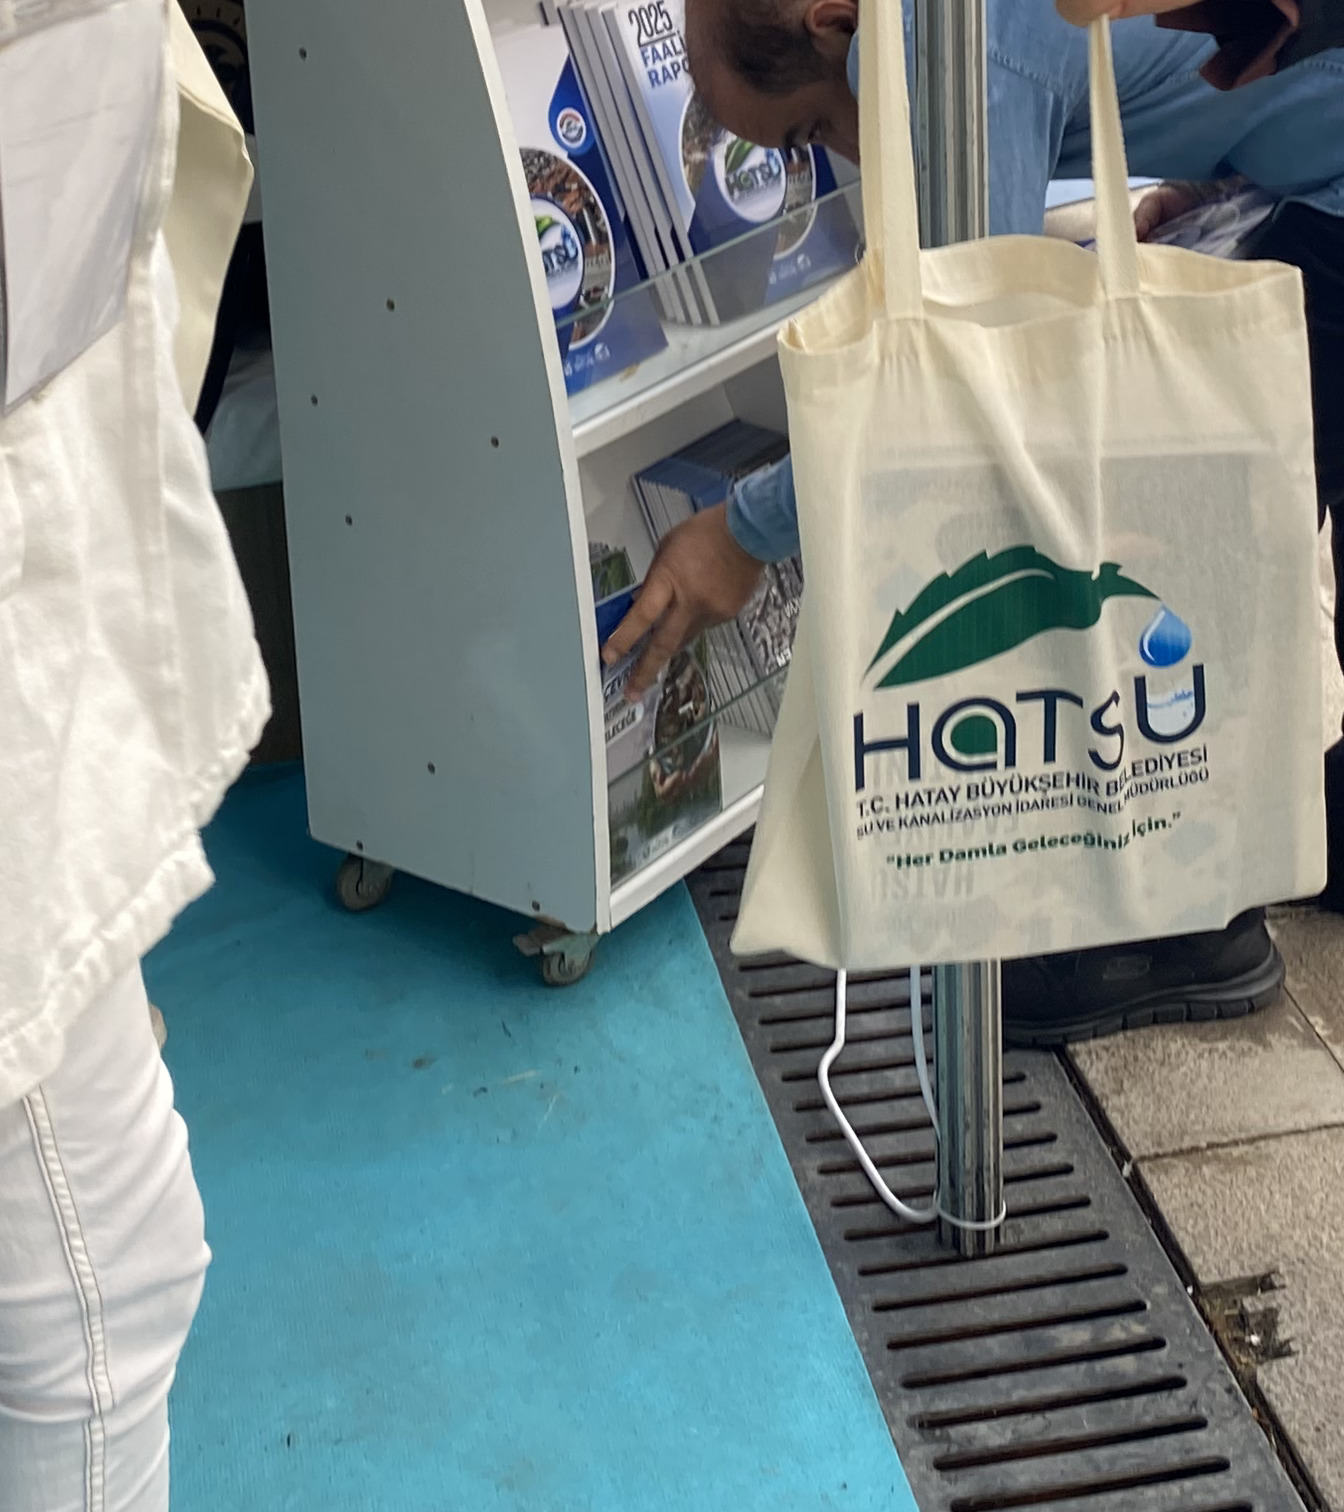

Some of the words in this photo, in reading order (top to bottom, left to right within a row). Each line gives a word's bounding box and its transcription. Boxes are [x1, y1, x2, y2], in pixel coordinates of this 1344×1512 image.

[639, 29, 688, 68] FAALİ
[647, 55, 690, 89] RAPO
[853, 662, 1207, 793] HATSU
[856, 795, 890, 820] T.C.
[895, 783, 962, 811] HATAY
[966, 770, 1101, 801] BÜYÜKŞEHİR
[1105, 743, 1208, 797] BELEDİYESİ
[876, 819, 896, 834] VE
[898, 802, 1013, 830] KANALİZASYON
[1016, 792, 1074, 815] İDARESİ
[1076, 796, 1124, 816] GENEL
[1124, 768, 1210, 806] MÜDÜRLÜĞÜ
[939, 841, 1008, 864] Damla
[1011, 829, 1130, 854] Geleceğiniz
